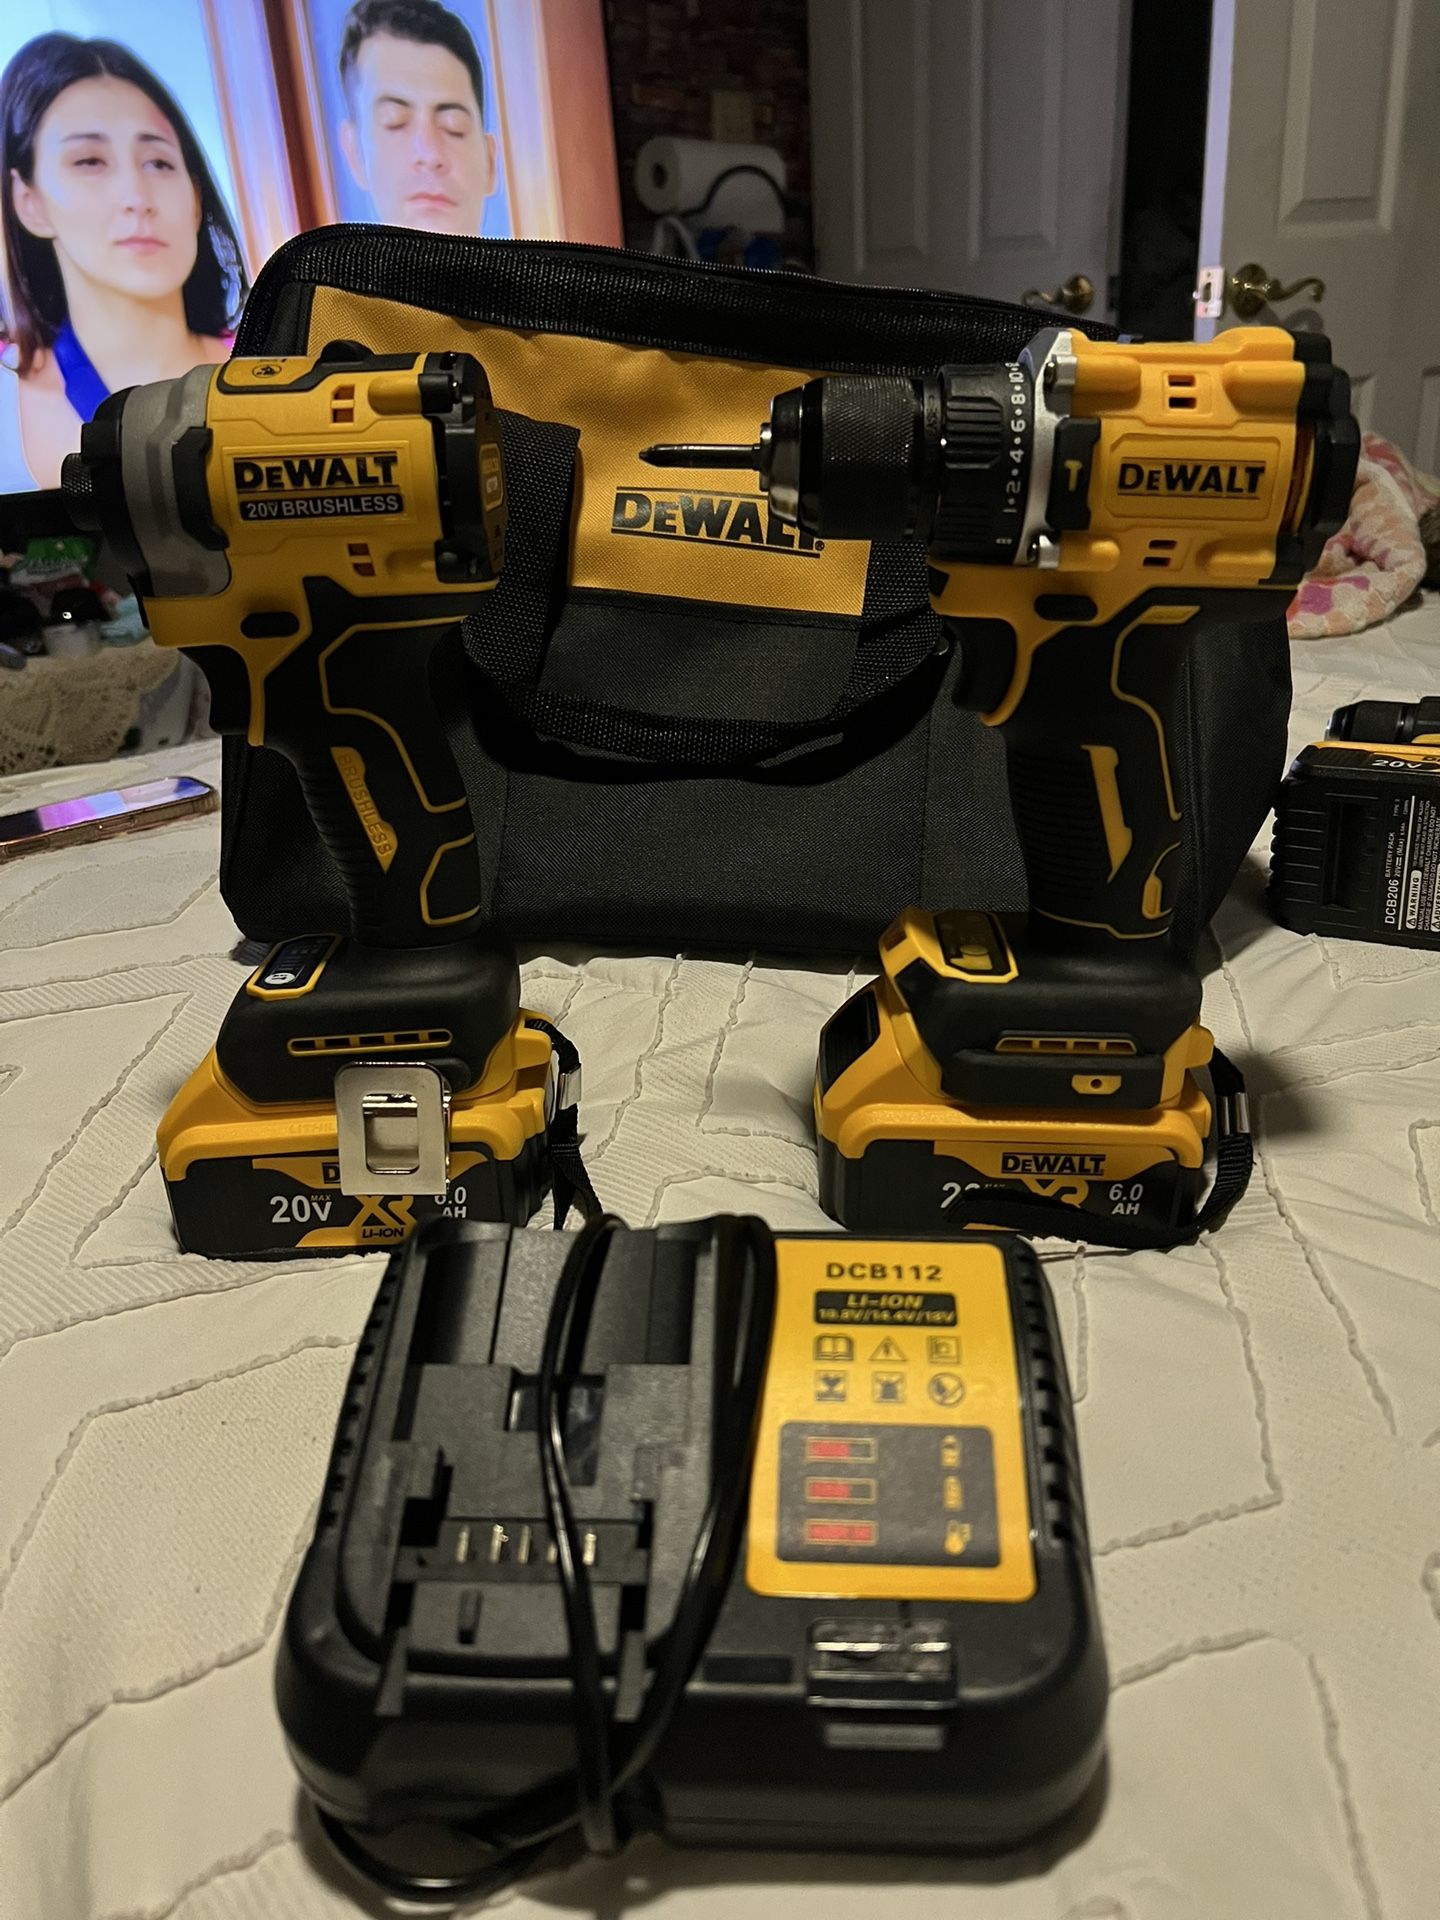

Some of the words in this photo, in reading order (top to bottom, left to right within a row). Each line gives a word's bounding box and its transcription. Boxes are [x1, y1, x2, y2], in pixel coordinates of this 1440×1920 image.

[233, 455, 398, 490] DEWALT
[1117, 463, 1266, 494] DEWALT
[282, 495, 399, 516] BRUSHLESS
[1371, 759, 1423, 769] 20V
[340, 752, 393, 856] BRUSHLESS
[1387, 832, 1395, 849] PACK
[1384, 879, 1400, 924] DCB206
[1409, 877, 1420, 917] WARNING
[1003, 1155, 1104, 1173] DEWALT
[1109, 1183, 1143, 1201] 6.0
[269, 1195, 332, 1223] 20V
[442, 1206, 467, 1219] AH
[1111, 1202, 1141, 1216] AH
[362, 1228, 404, 1239] LI-ION
[826, 1262, 943, 1281] DCB112
[847, 1294, 925, 1310] LI-ION
